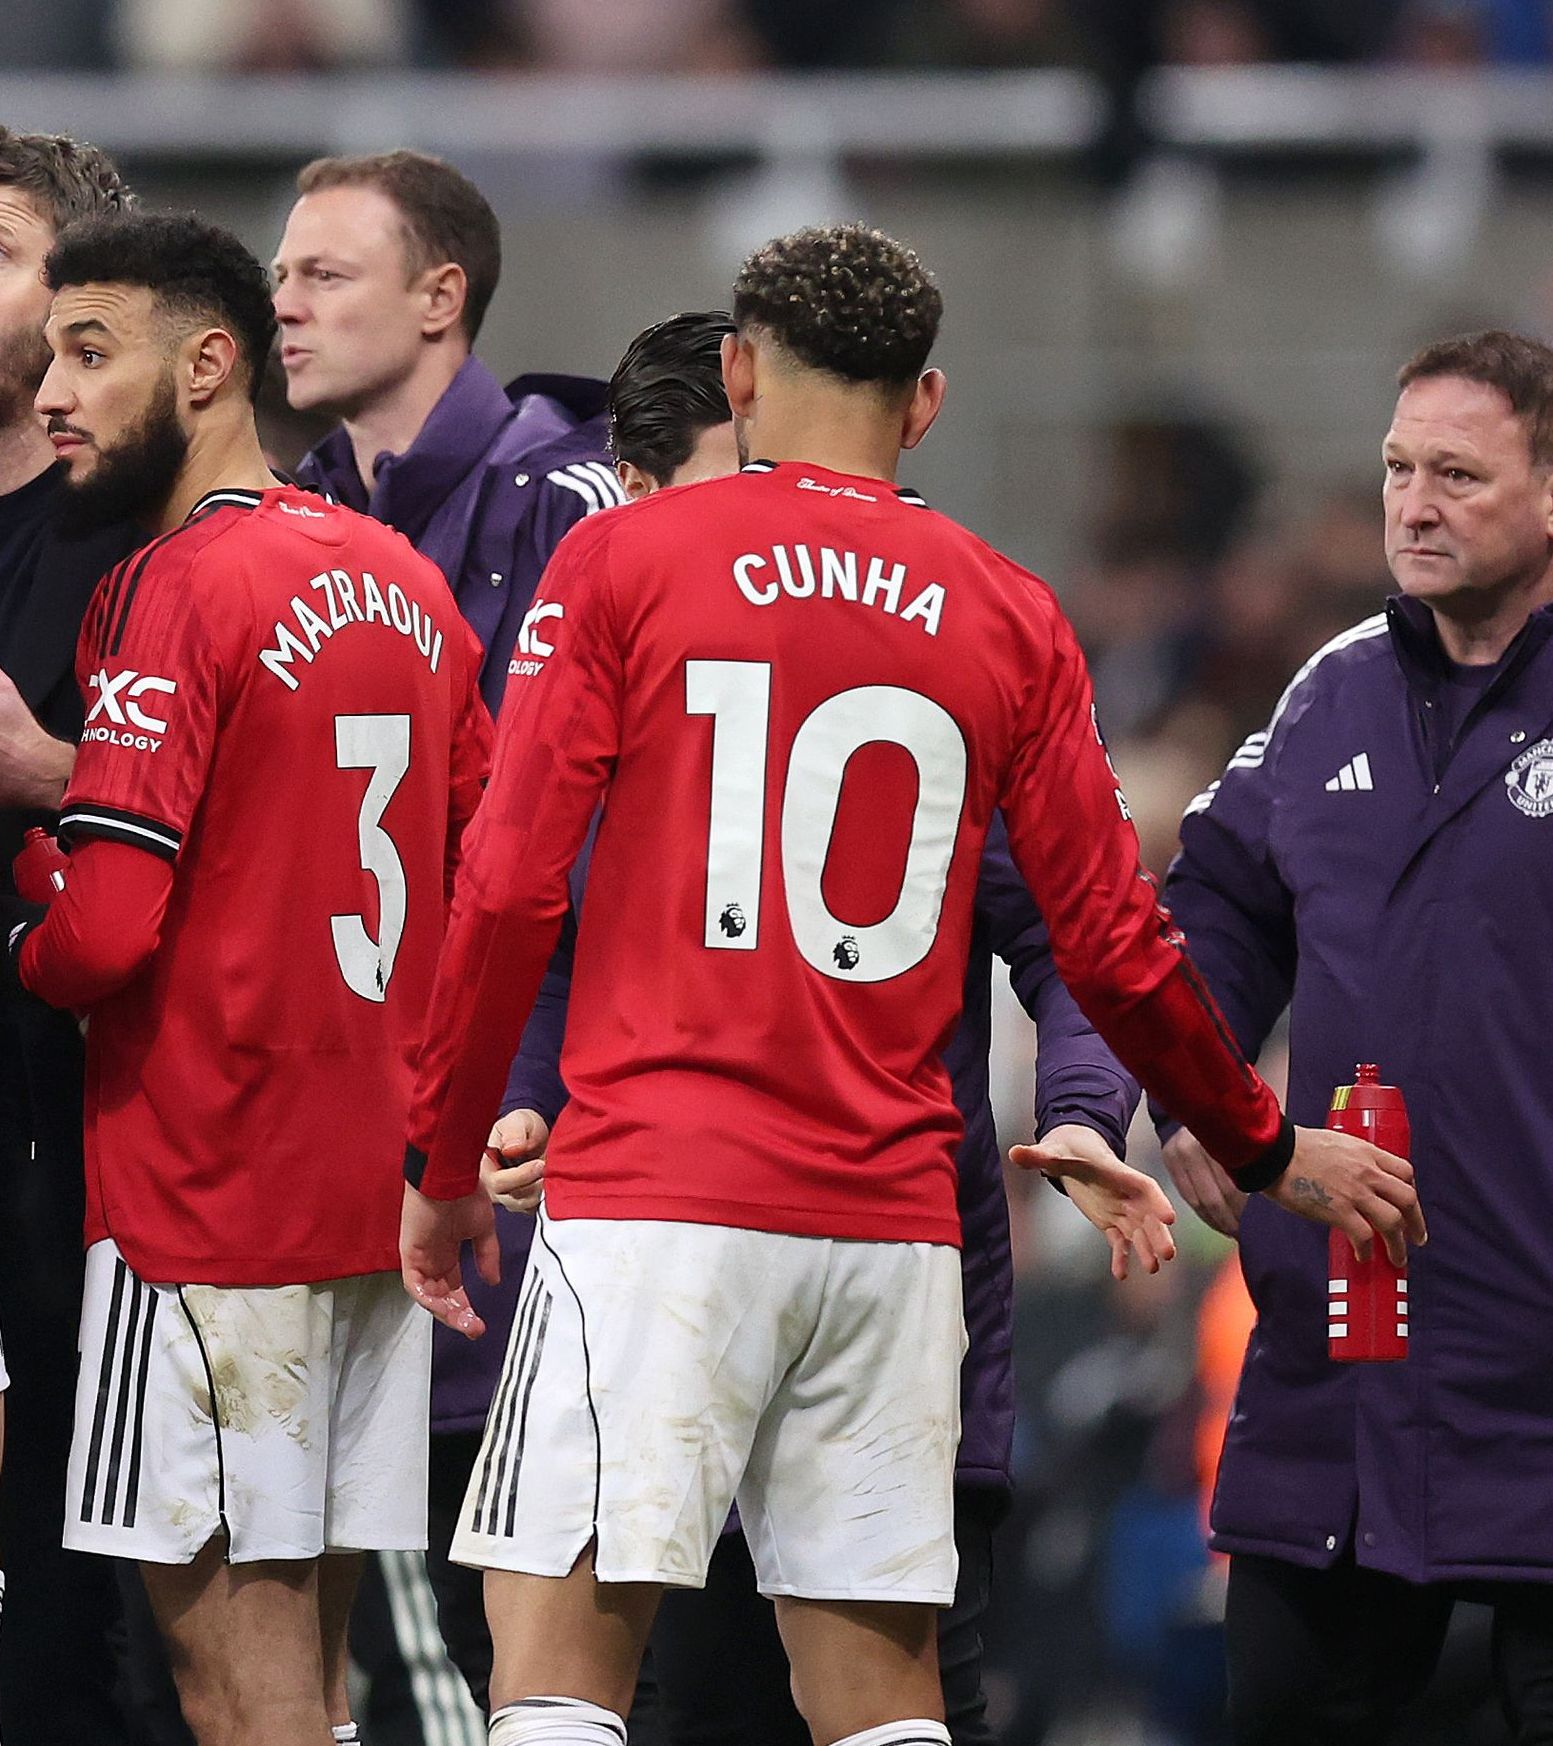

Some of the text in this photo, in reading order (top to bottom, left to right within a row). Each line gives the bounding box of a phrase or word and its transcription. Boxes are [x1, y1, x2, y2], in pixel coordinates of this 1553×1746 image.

[258, 569, 443, 691] MAZRAOUI
[733, 544, 946, 636] CUNHA
[508, 659, 545, 677] OLOGY
[80, 727, 163, 754] HNOLOGY
[330, 714, 410, 1002] 3
[685, 660, 967, 983] 10
